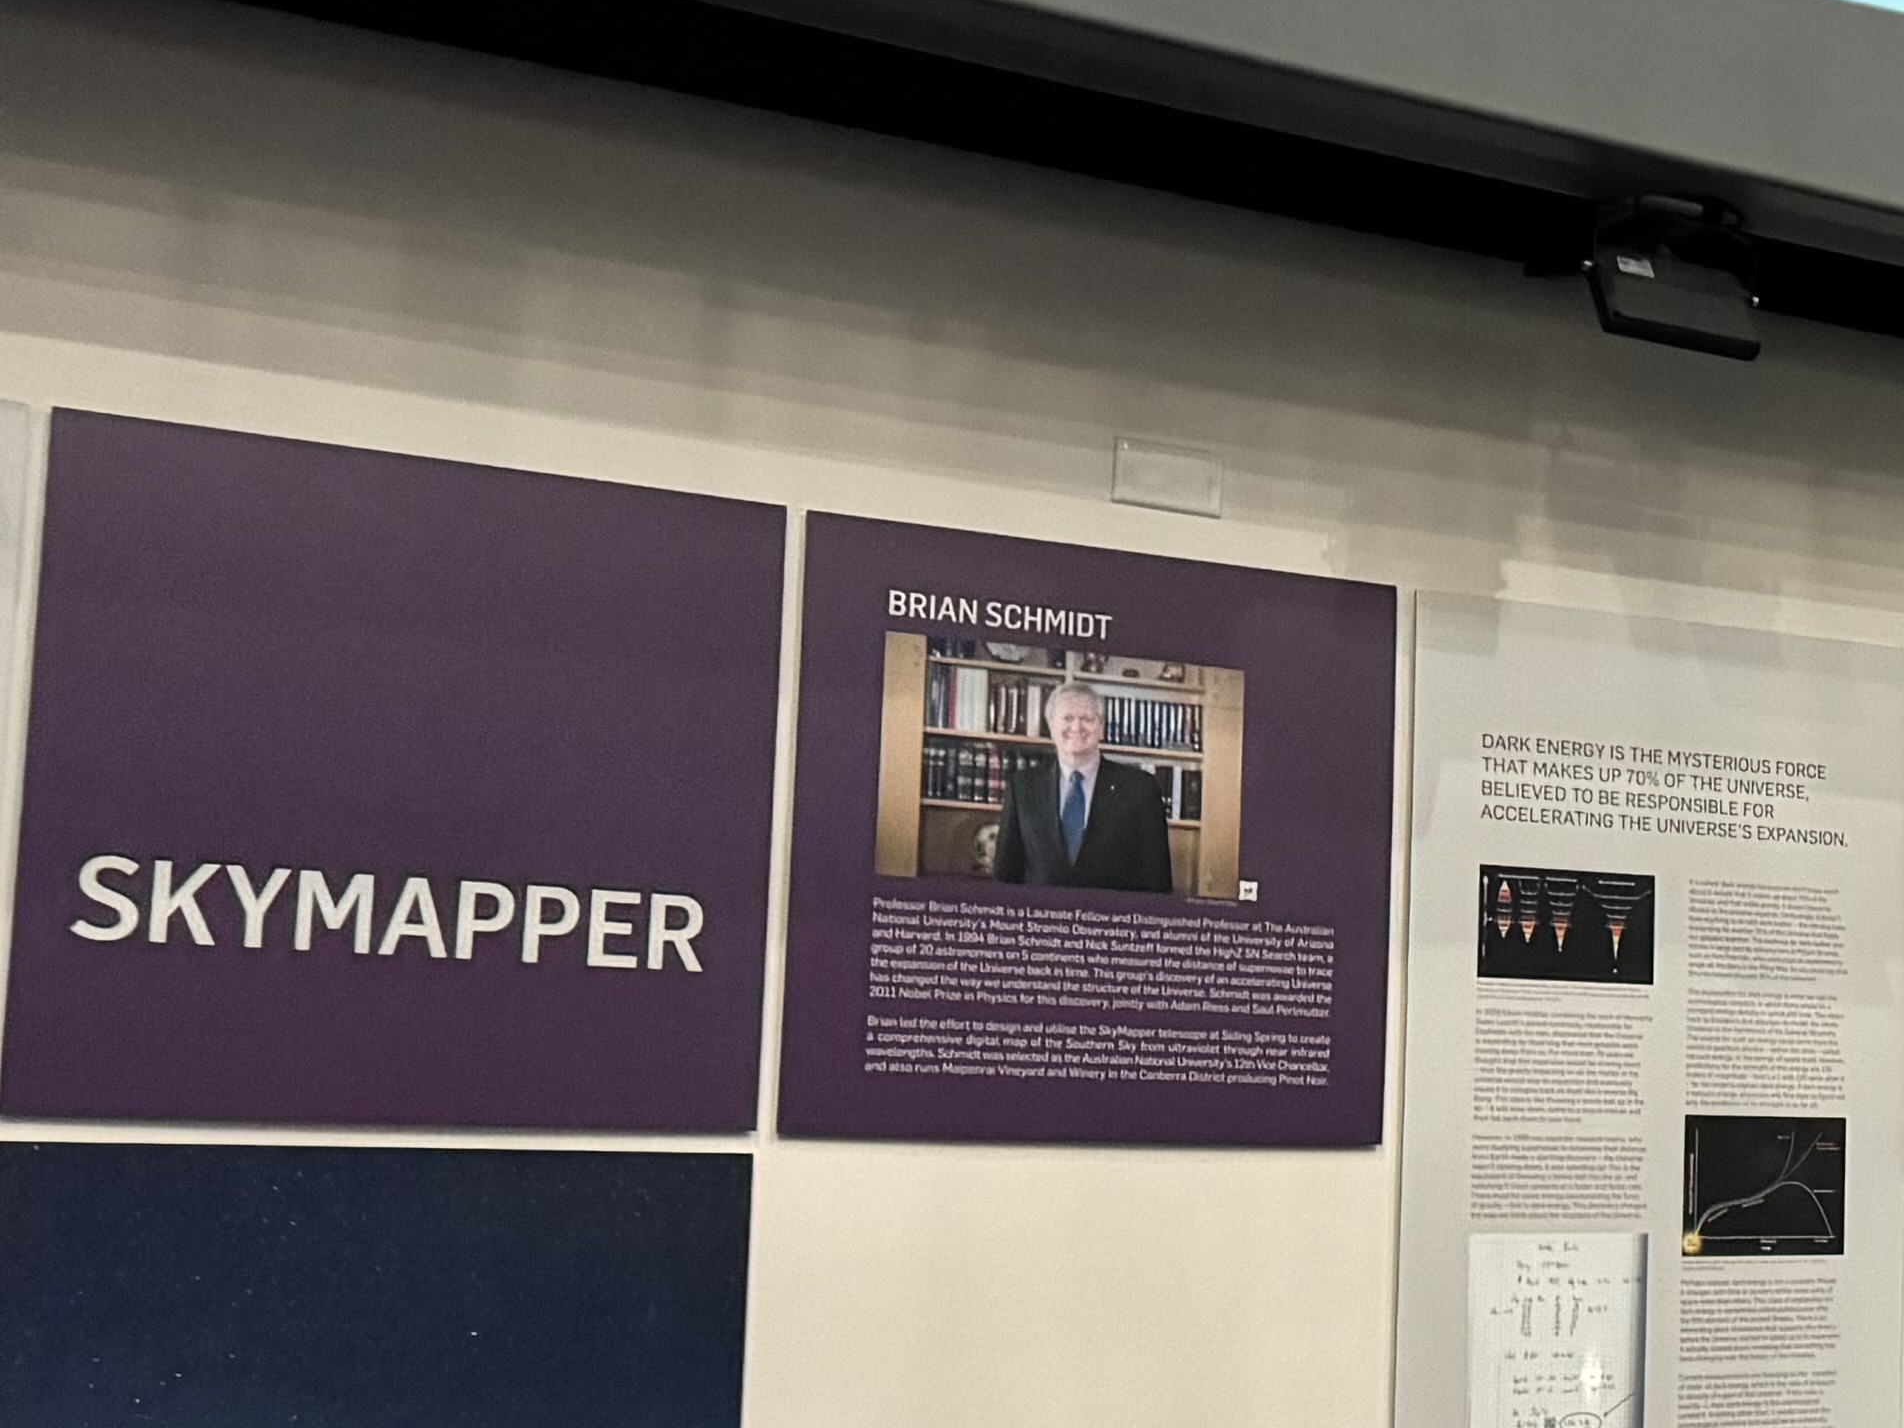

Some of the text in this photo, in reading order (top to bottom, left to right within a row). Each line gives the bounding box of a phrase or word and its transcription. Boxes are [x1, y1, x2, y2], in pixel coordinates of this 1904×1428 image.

[888, 589, 1112, 639] BRIAN SCHMIDT
[1481, 733, 1826, 779] DARK ENERGY IS THE MYSTERIOUS FORCE
[1482, 756, 1810, 799] THAT MAKES UP 70% OF THE UNIVERSE,
[1480, 779, 1774, 818] BELIEVED TO BE RESPONSIBLE FOR
[1480, 803, 1849, 846] ACCELERATING THE UNIVERSE'S EXPANSION.
[70, 854, 704, 973] SKYMAPPER
